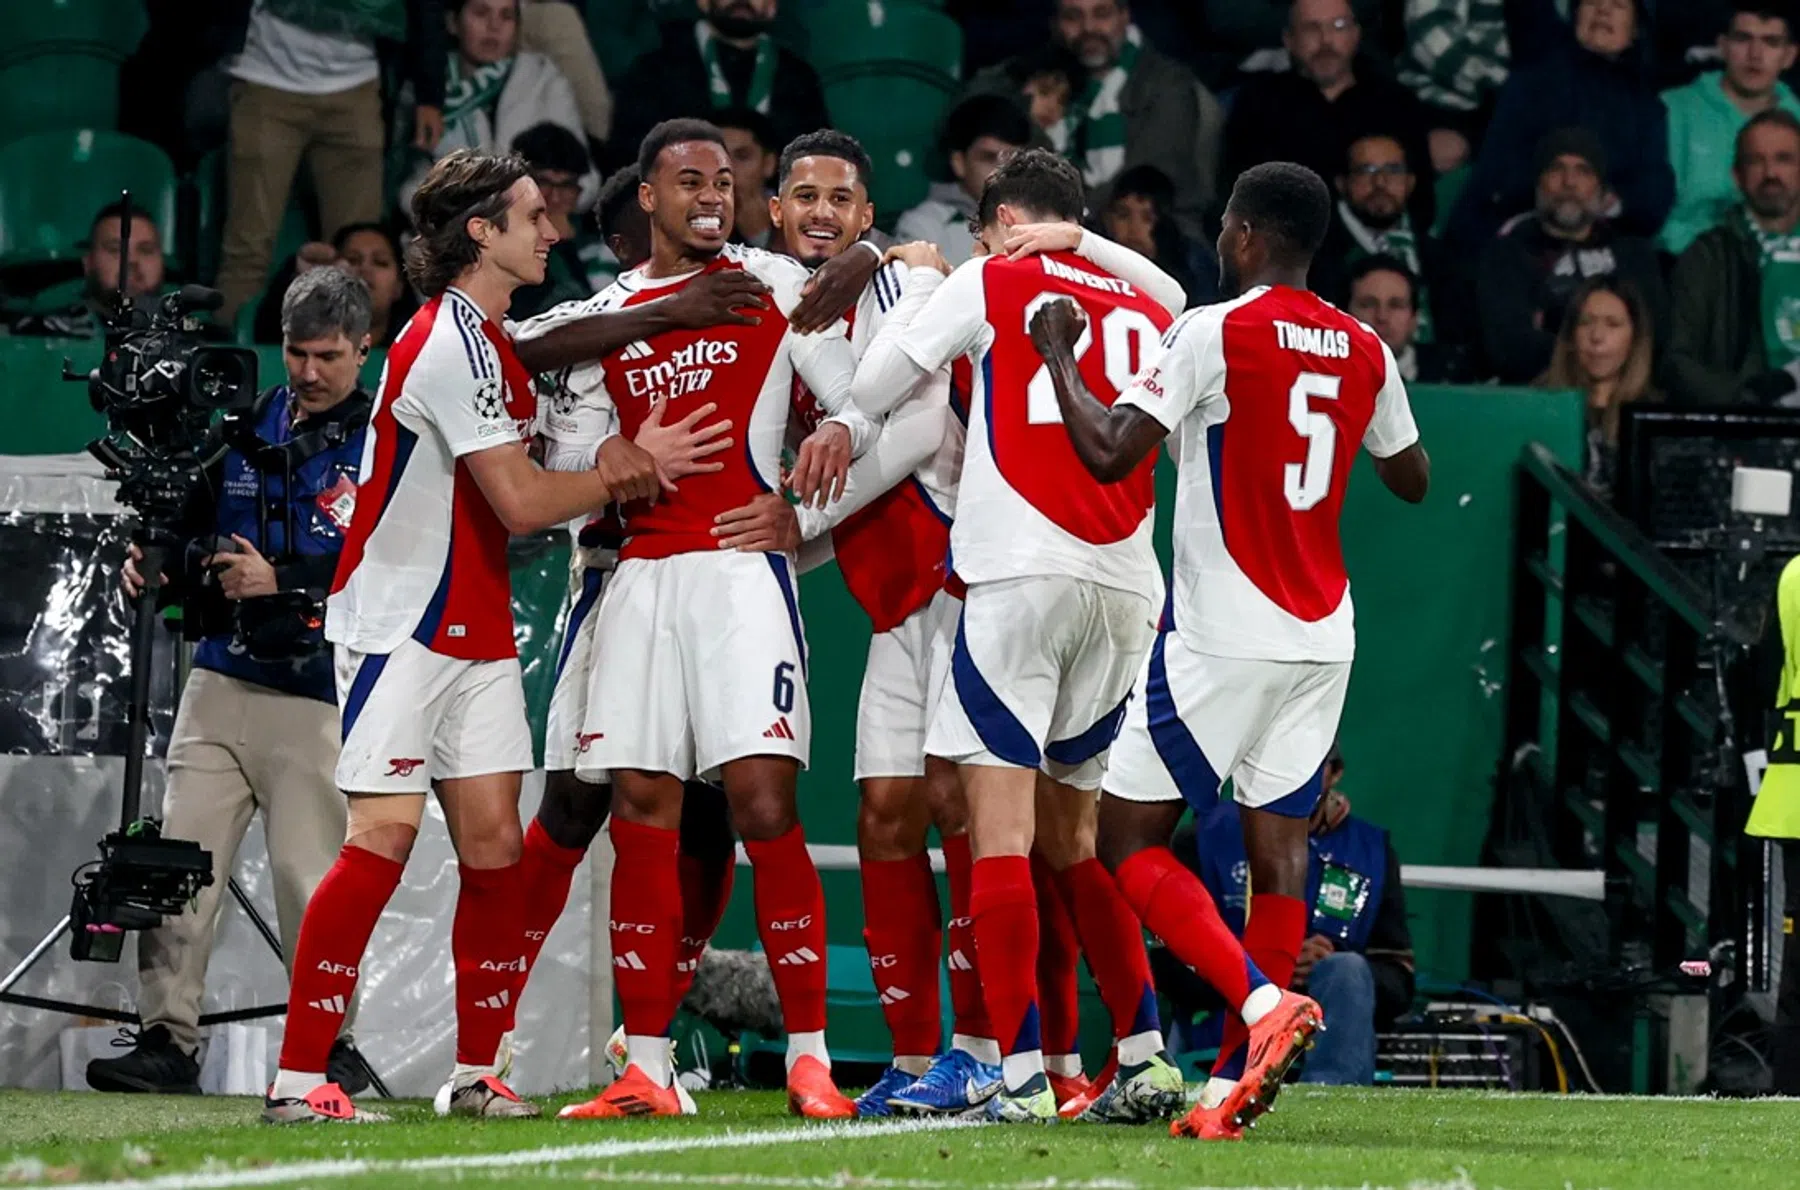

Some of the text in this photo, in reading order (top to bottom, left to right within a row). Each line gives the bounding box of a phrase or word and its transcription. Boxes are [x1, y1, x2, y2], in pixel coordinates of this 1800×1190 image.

[1273, 320, 1350, 359] THOMAS
[1284, 371, 1342, 510] 5
[773, 660, 795, 714] 6
[608, 919, 656, 934] AFC
[770, 914, 813, 931] AFC
[524, 930, 545, 941] FC
[317, 959, 357, 977] AFC
[479, 959, 521, 972] AFC
[870, 953, 898, 969] FC
